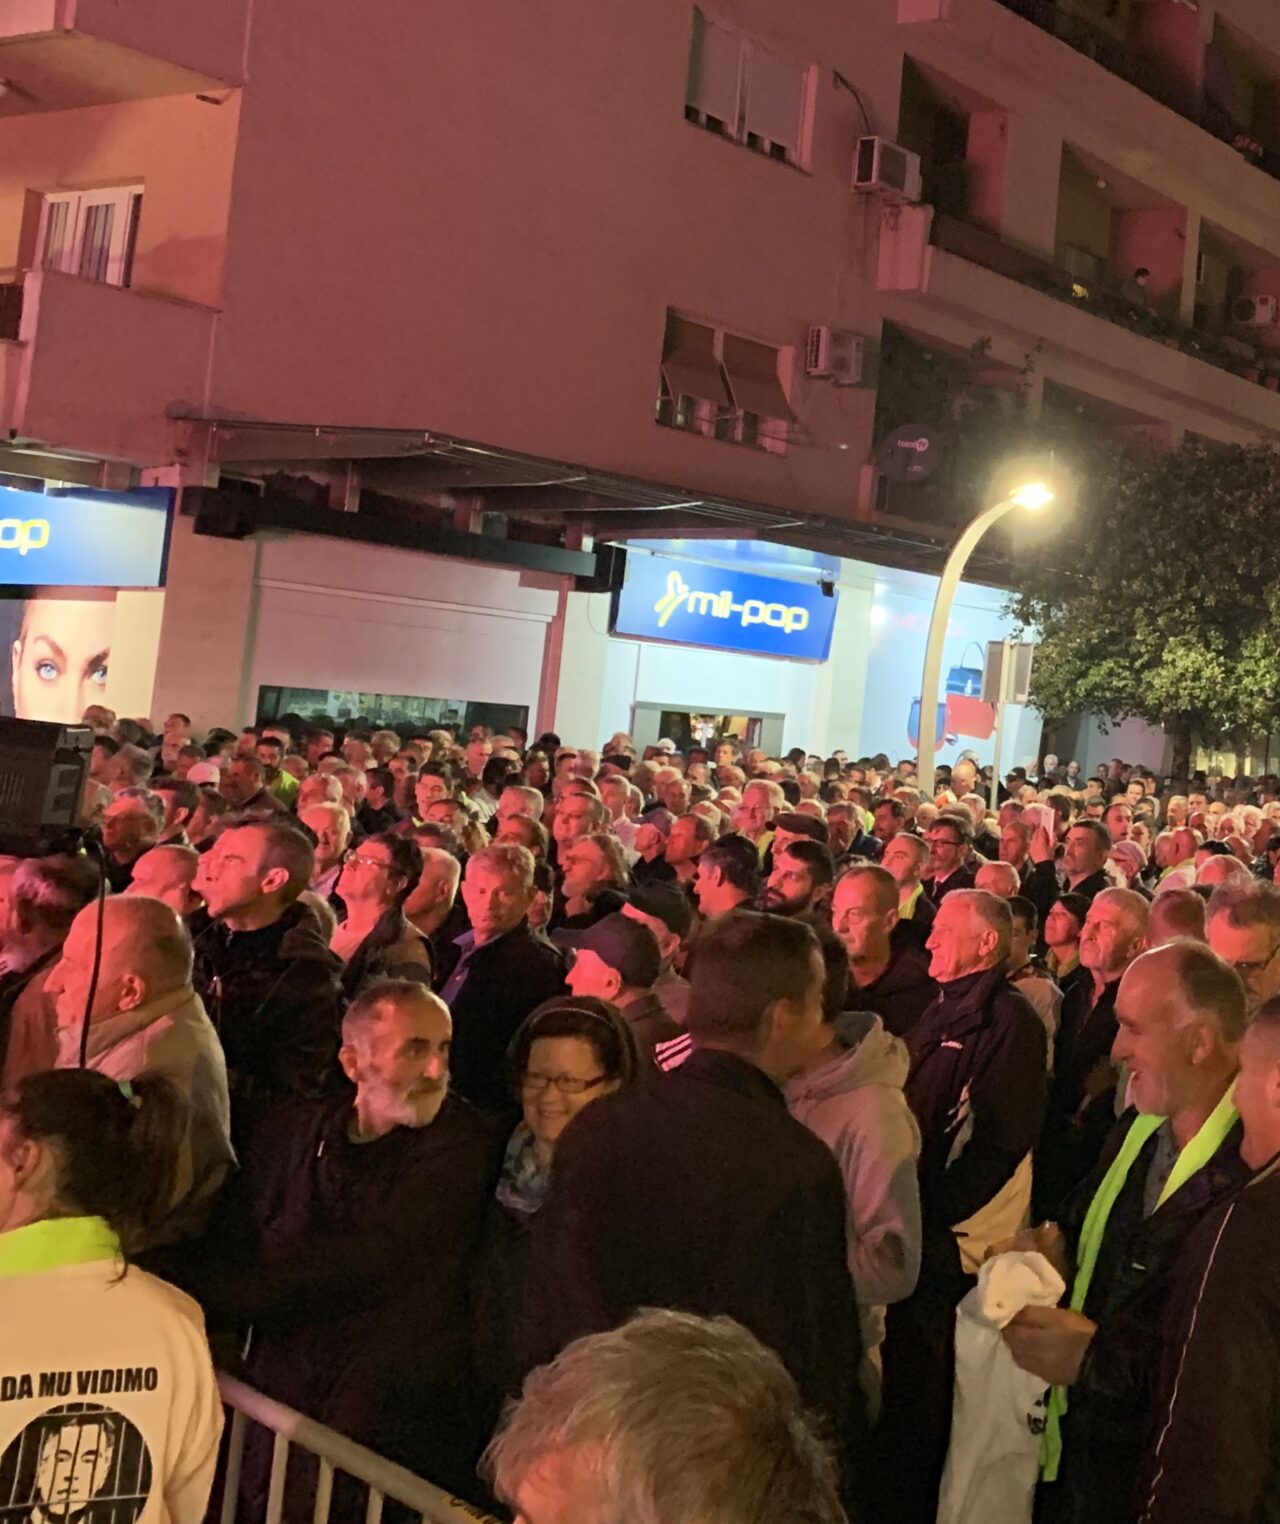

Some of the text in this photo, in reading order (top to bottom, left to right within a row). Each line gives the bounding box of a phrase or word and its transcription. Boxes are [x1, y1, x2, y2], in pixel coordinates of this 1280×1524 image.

[687, 591, 809, 633] mil-pop
[0, 1367, 158, 1401] DA MU VIDIMO
